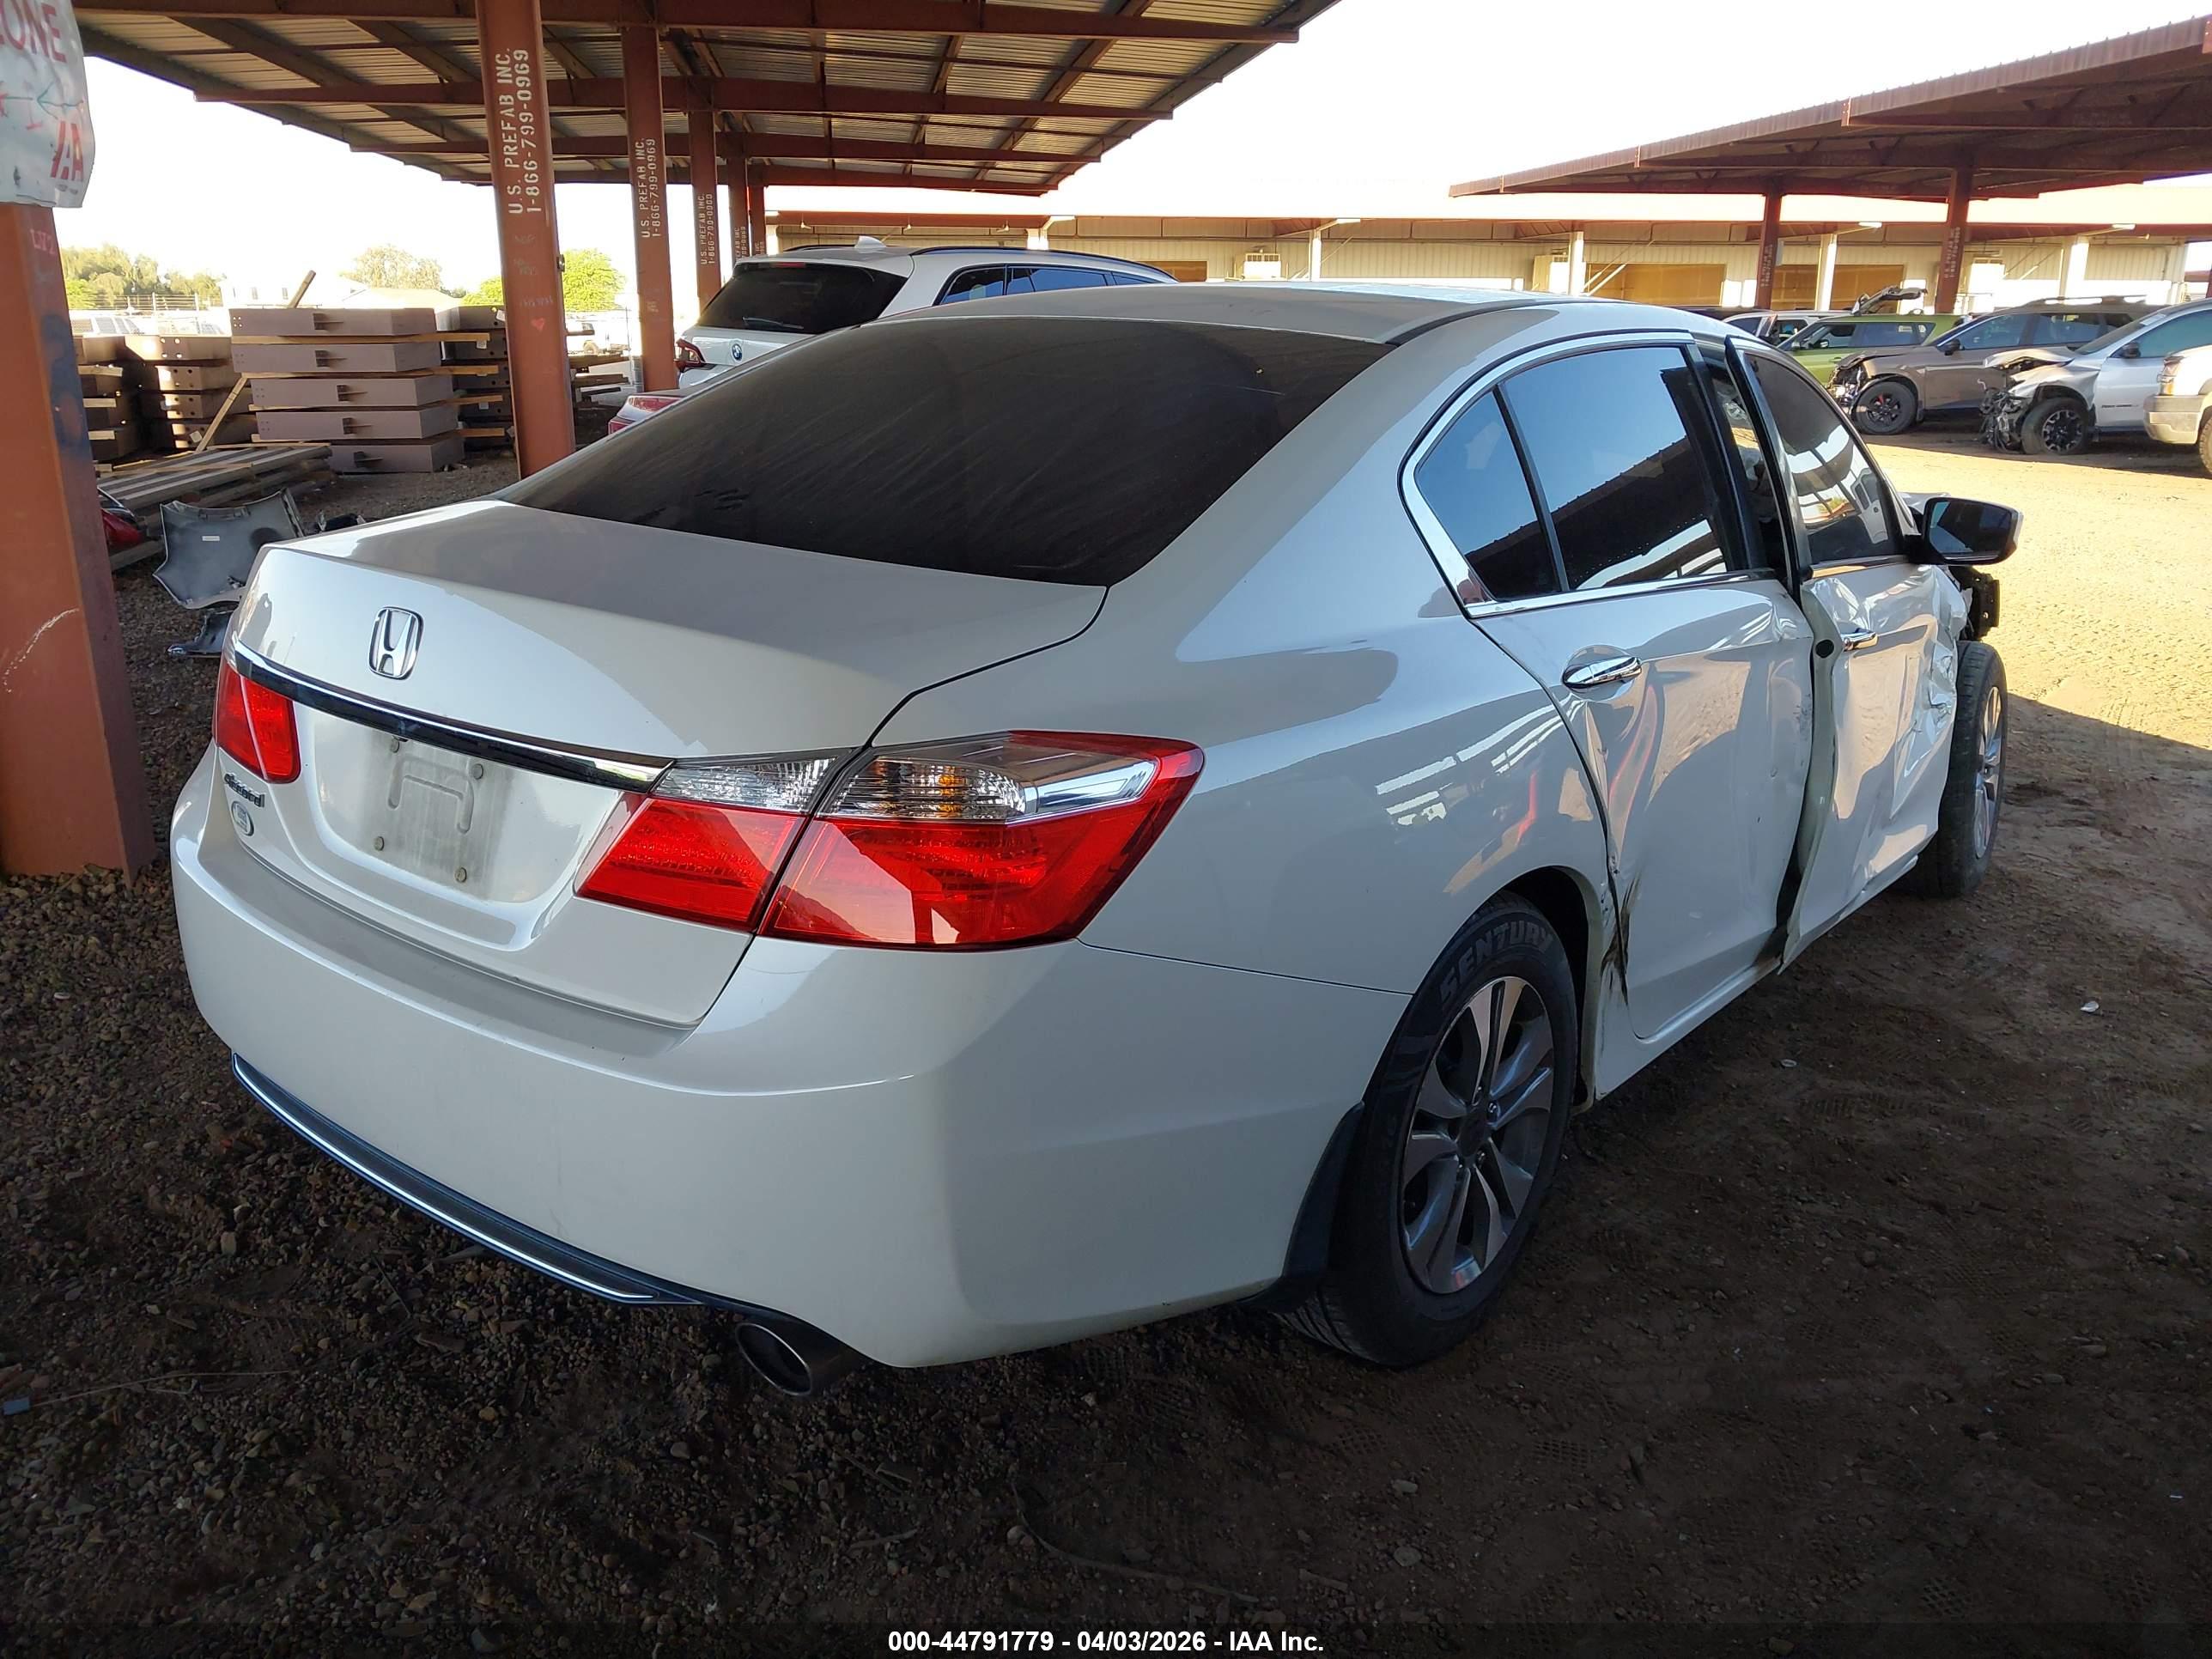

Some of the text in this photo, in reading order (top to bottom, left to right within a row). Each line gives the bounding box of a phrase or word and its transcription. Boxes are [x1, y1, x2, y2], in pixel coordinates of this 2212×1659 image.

[0, 0, 67, 63] ONE
[495, 47, 524, 214] U.S. PREFAB INC.
[513, 49, 542, 212] 1-866-799-0969
[635, 137, 651, 238] U.S. PREFAB INC.
[1438, 920, 1554, 1004] SENTURY
